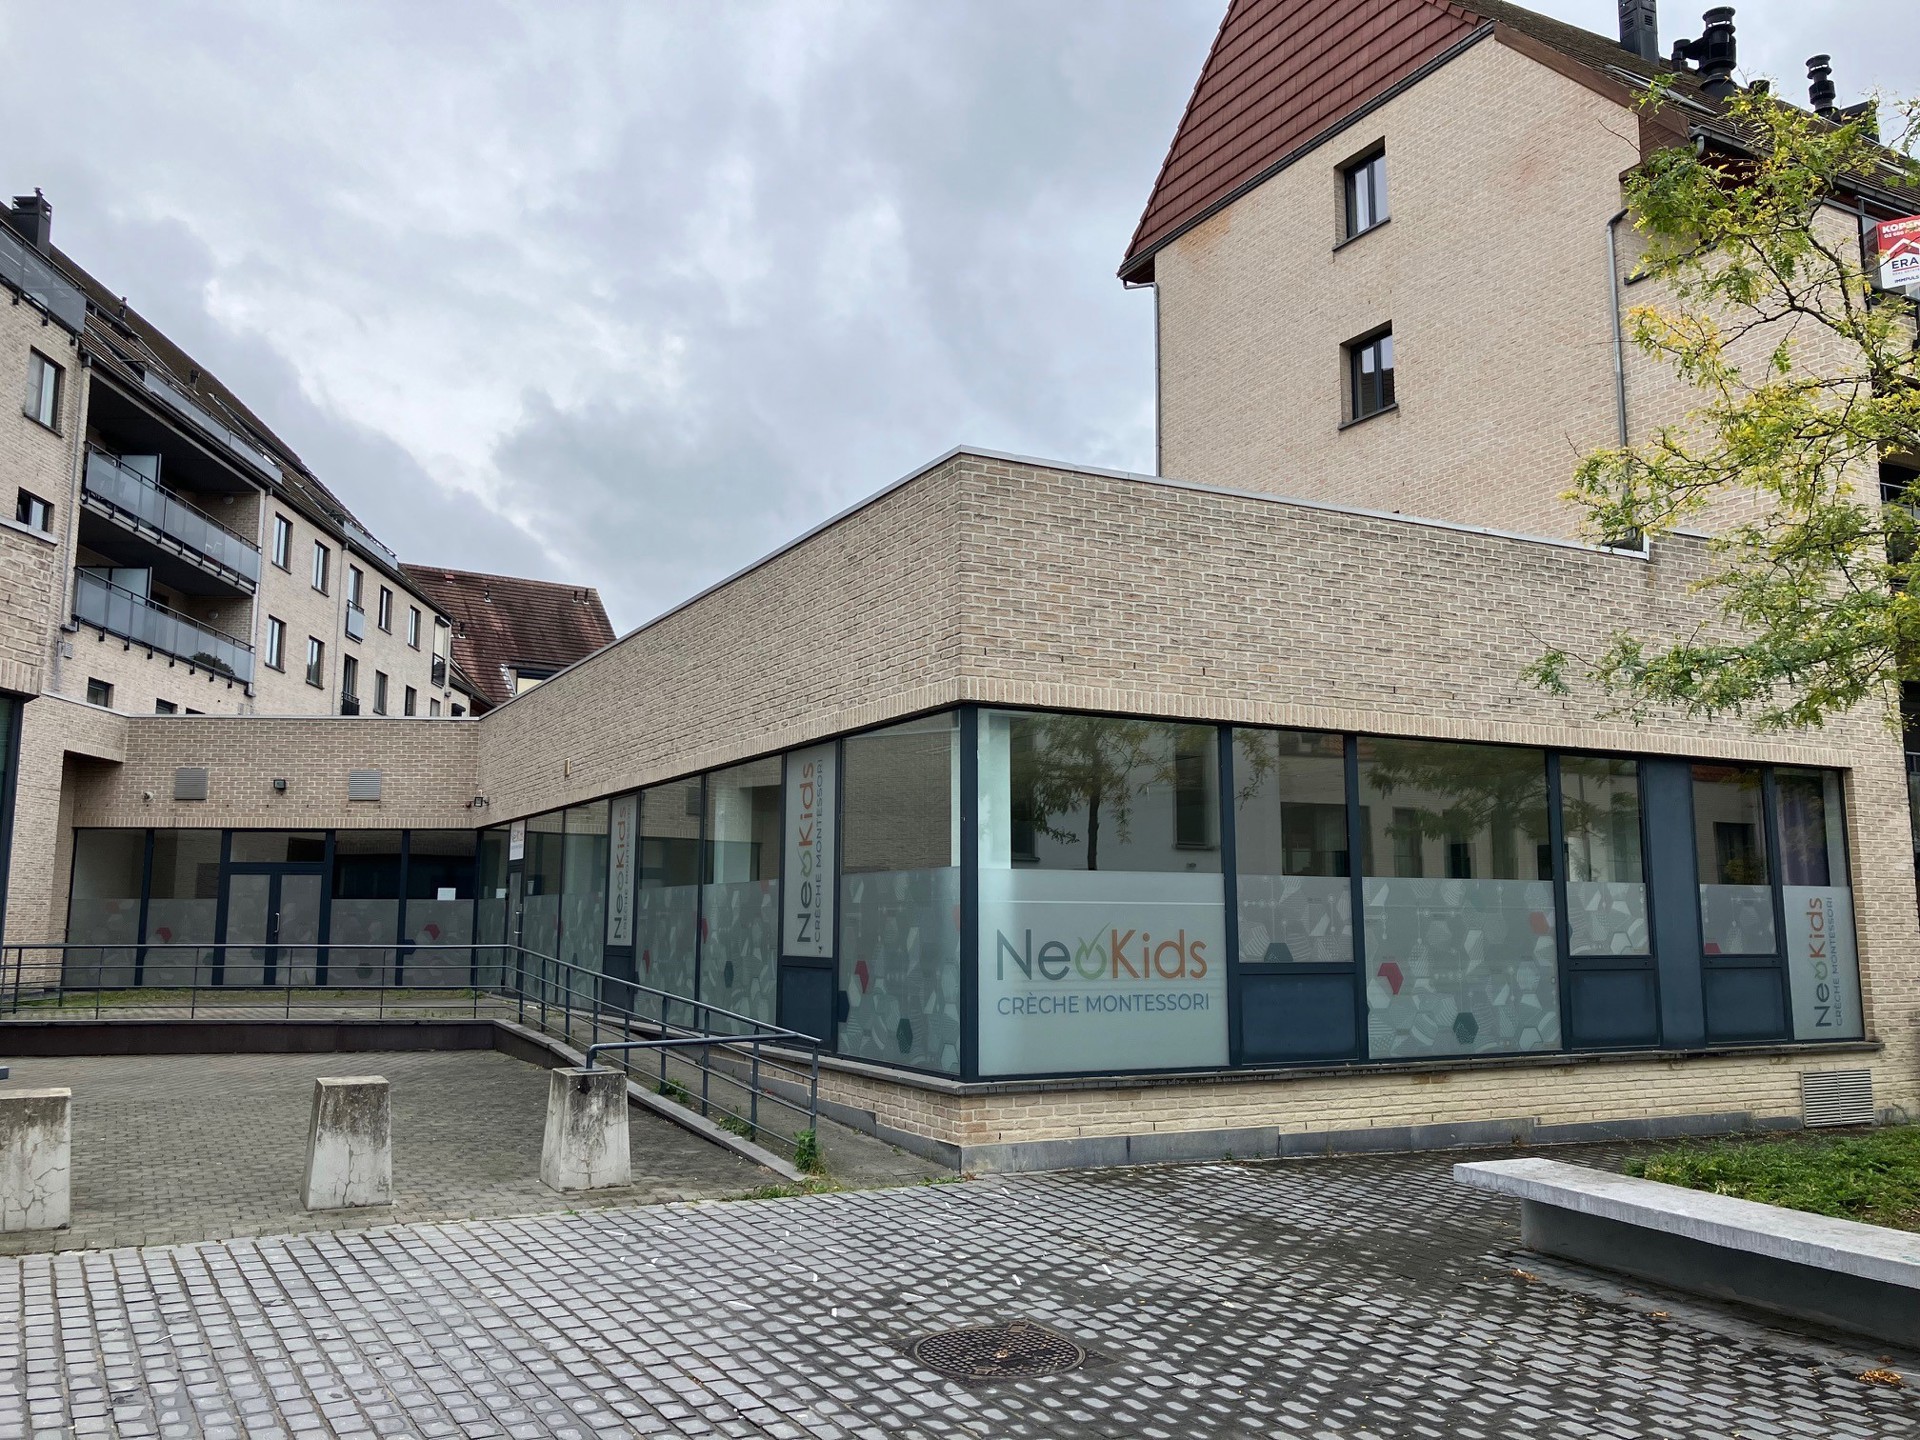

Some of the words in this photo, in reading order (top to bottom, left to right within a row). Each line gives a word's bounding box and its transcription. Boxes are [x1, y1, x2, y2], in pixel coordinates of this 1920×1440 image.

[1892, 257, 1919, 269] ERA
[796, 763, 814, 943] NeoKids
[997, 922, 1208, 981] NeoKids
[1806, 898, 1832, 1028] NeoKids
[1826, 897, 1839, 975] MONTESSORI
[997, 992, 1079, 1015] CRÈCHE
[1086, 993, 1210, 1013] MONTESSORI
